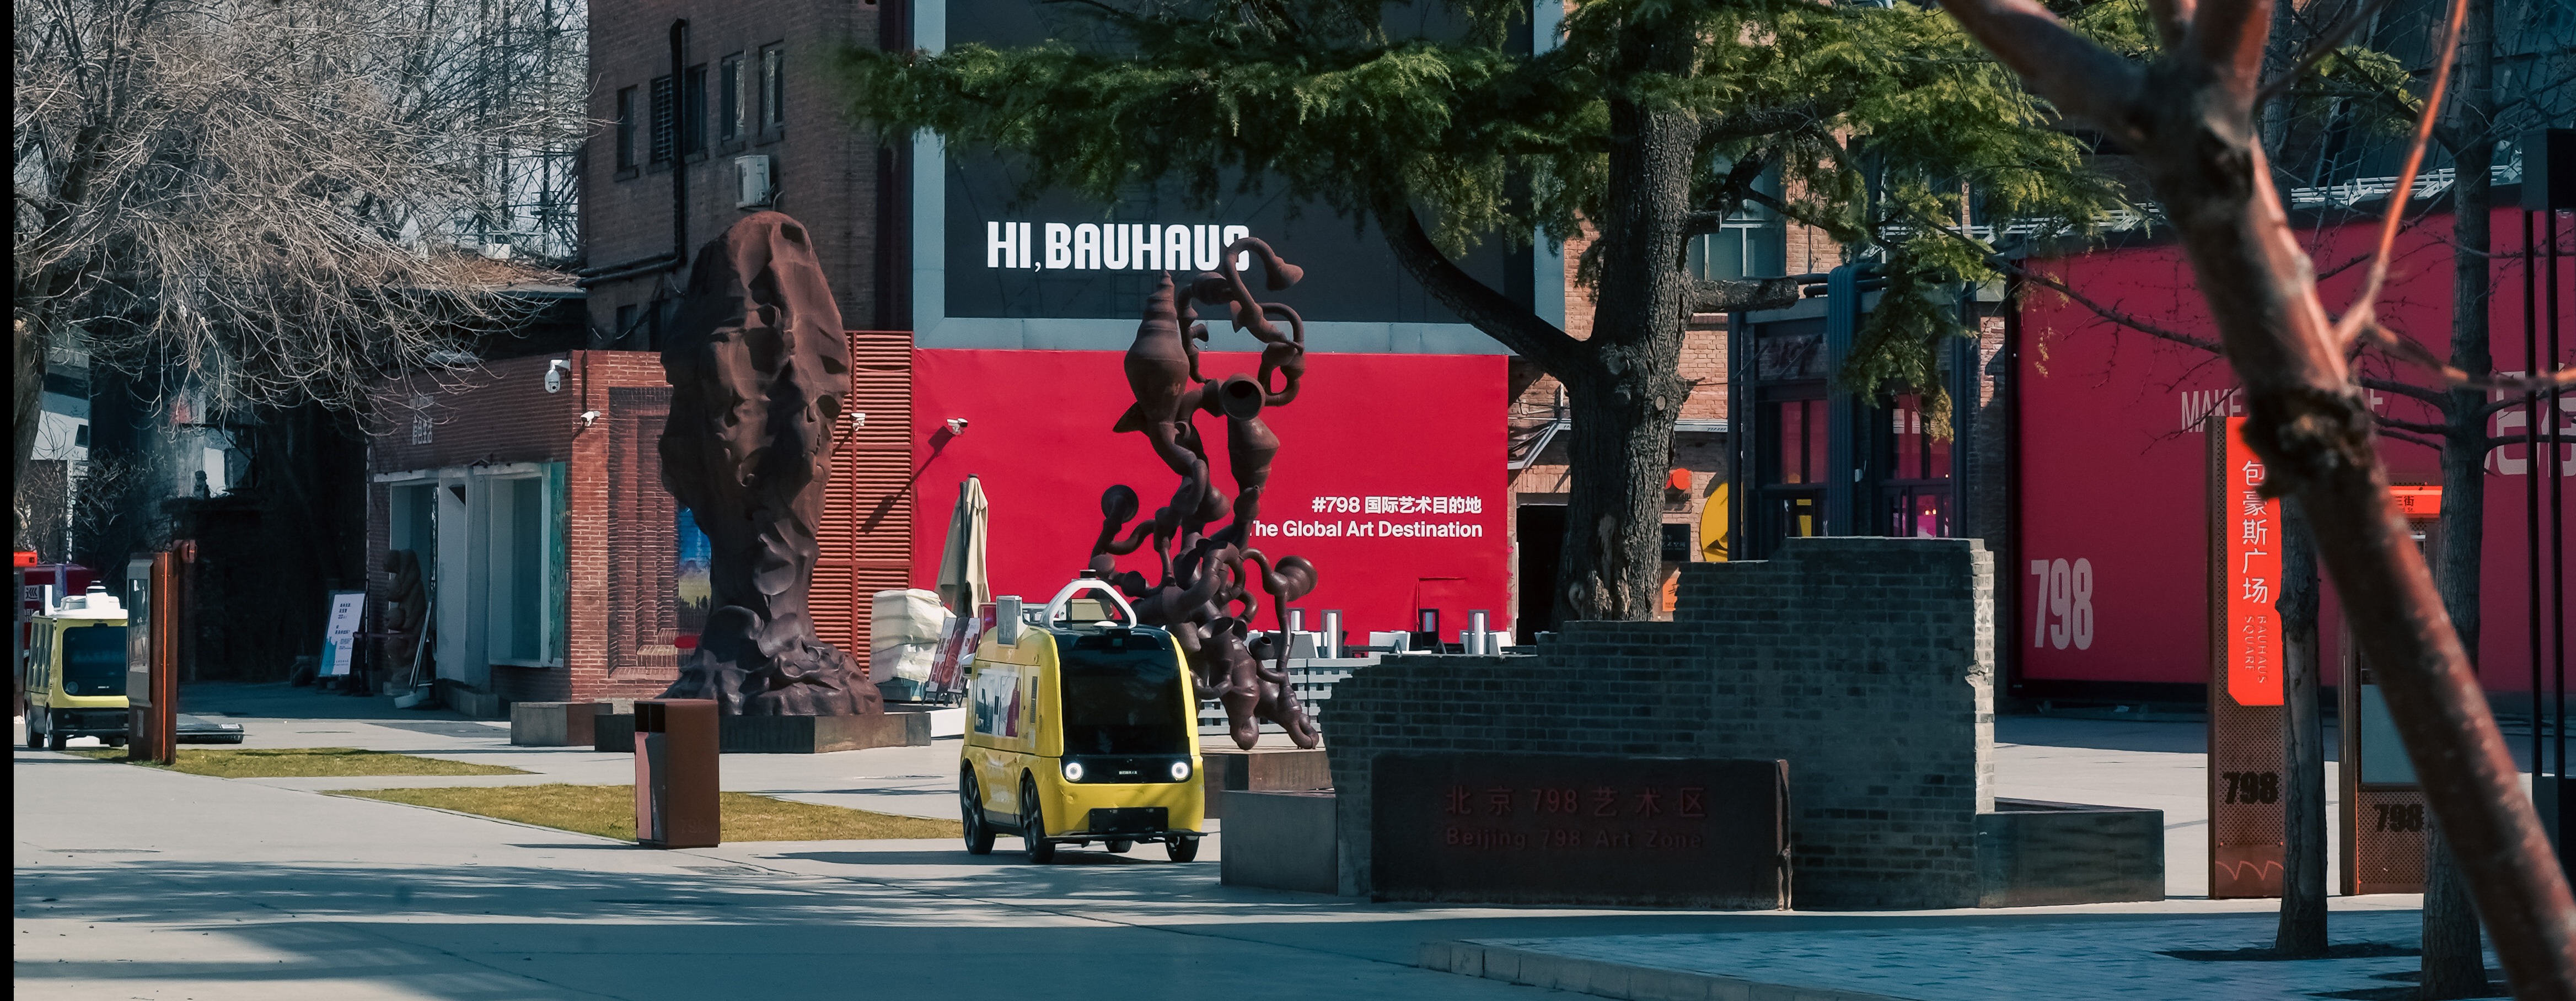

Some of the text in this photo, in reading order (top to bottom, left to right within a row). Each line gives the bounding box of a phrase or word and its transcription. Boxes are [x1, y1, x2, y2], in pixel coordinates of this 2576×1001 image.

[1312, 497, 1360, 513] #798
[1365, 496, 1482, 514] 国际艺术目的地
[1282, 520, 1342, 537] Global
[1346, 520, 1374, 537] Art
[1378, 520, 1482, 537] Destination
[2242, 460, 2268, 604] 包豪斯广场
[2031, 558, 2094, 650] 798
[2242, 615, 2255, 671] SQUARE
[2257, 615, 2268, 684] BAUHAUS
[1531, 788, 1578, 814] 798
[1592, 785, 1705, 818] 艺术区
[2223, 772, 2282, 805] 798
[2373, 804, 2423, 832] 798
[1446, 826, 1703, 852] Beijing 798 Art Zone
